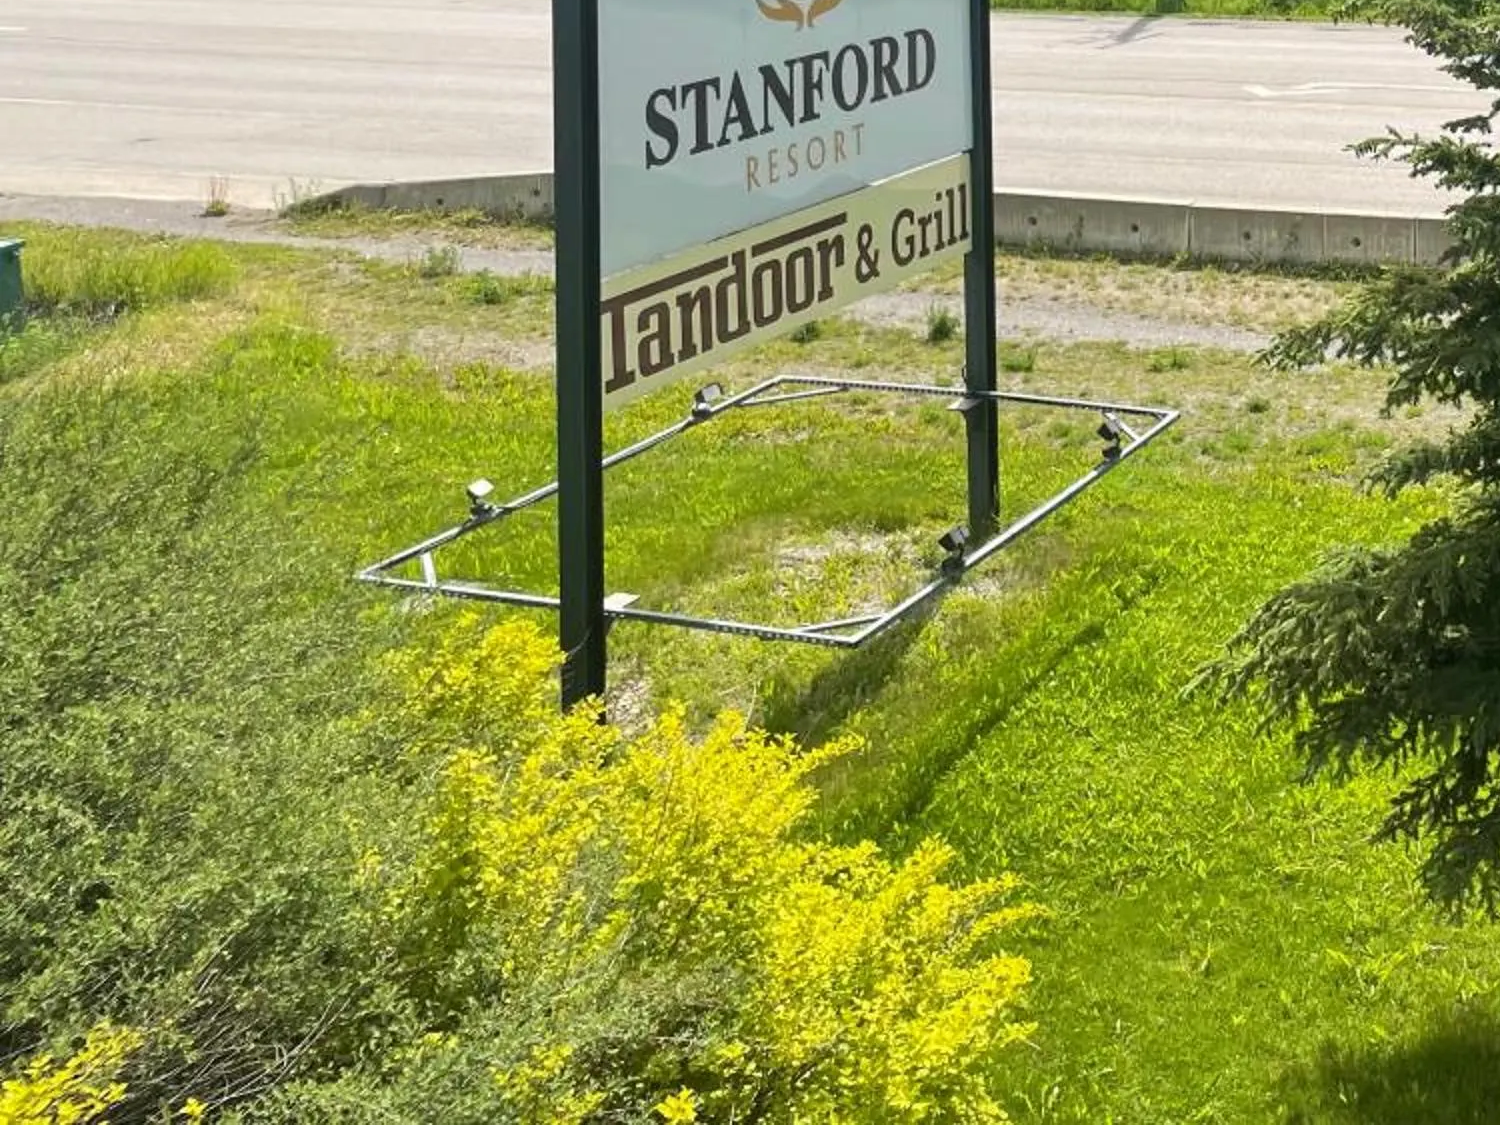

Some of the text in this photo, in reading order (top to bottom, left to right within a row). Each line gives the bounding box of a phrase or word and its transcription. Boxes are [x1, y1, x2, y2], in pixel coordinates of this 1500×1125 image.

[646, 28, 936, 169] STANFORD
[746, 123, 865, 191] RESORT
[601, 183, 970, 393] Tandoor & Grill
